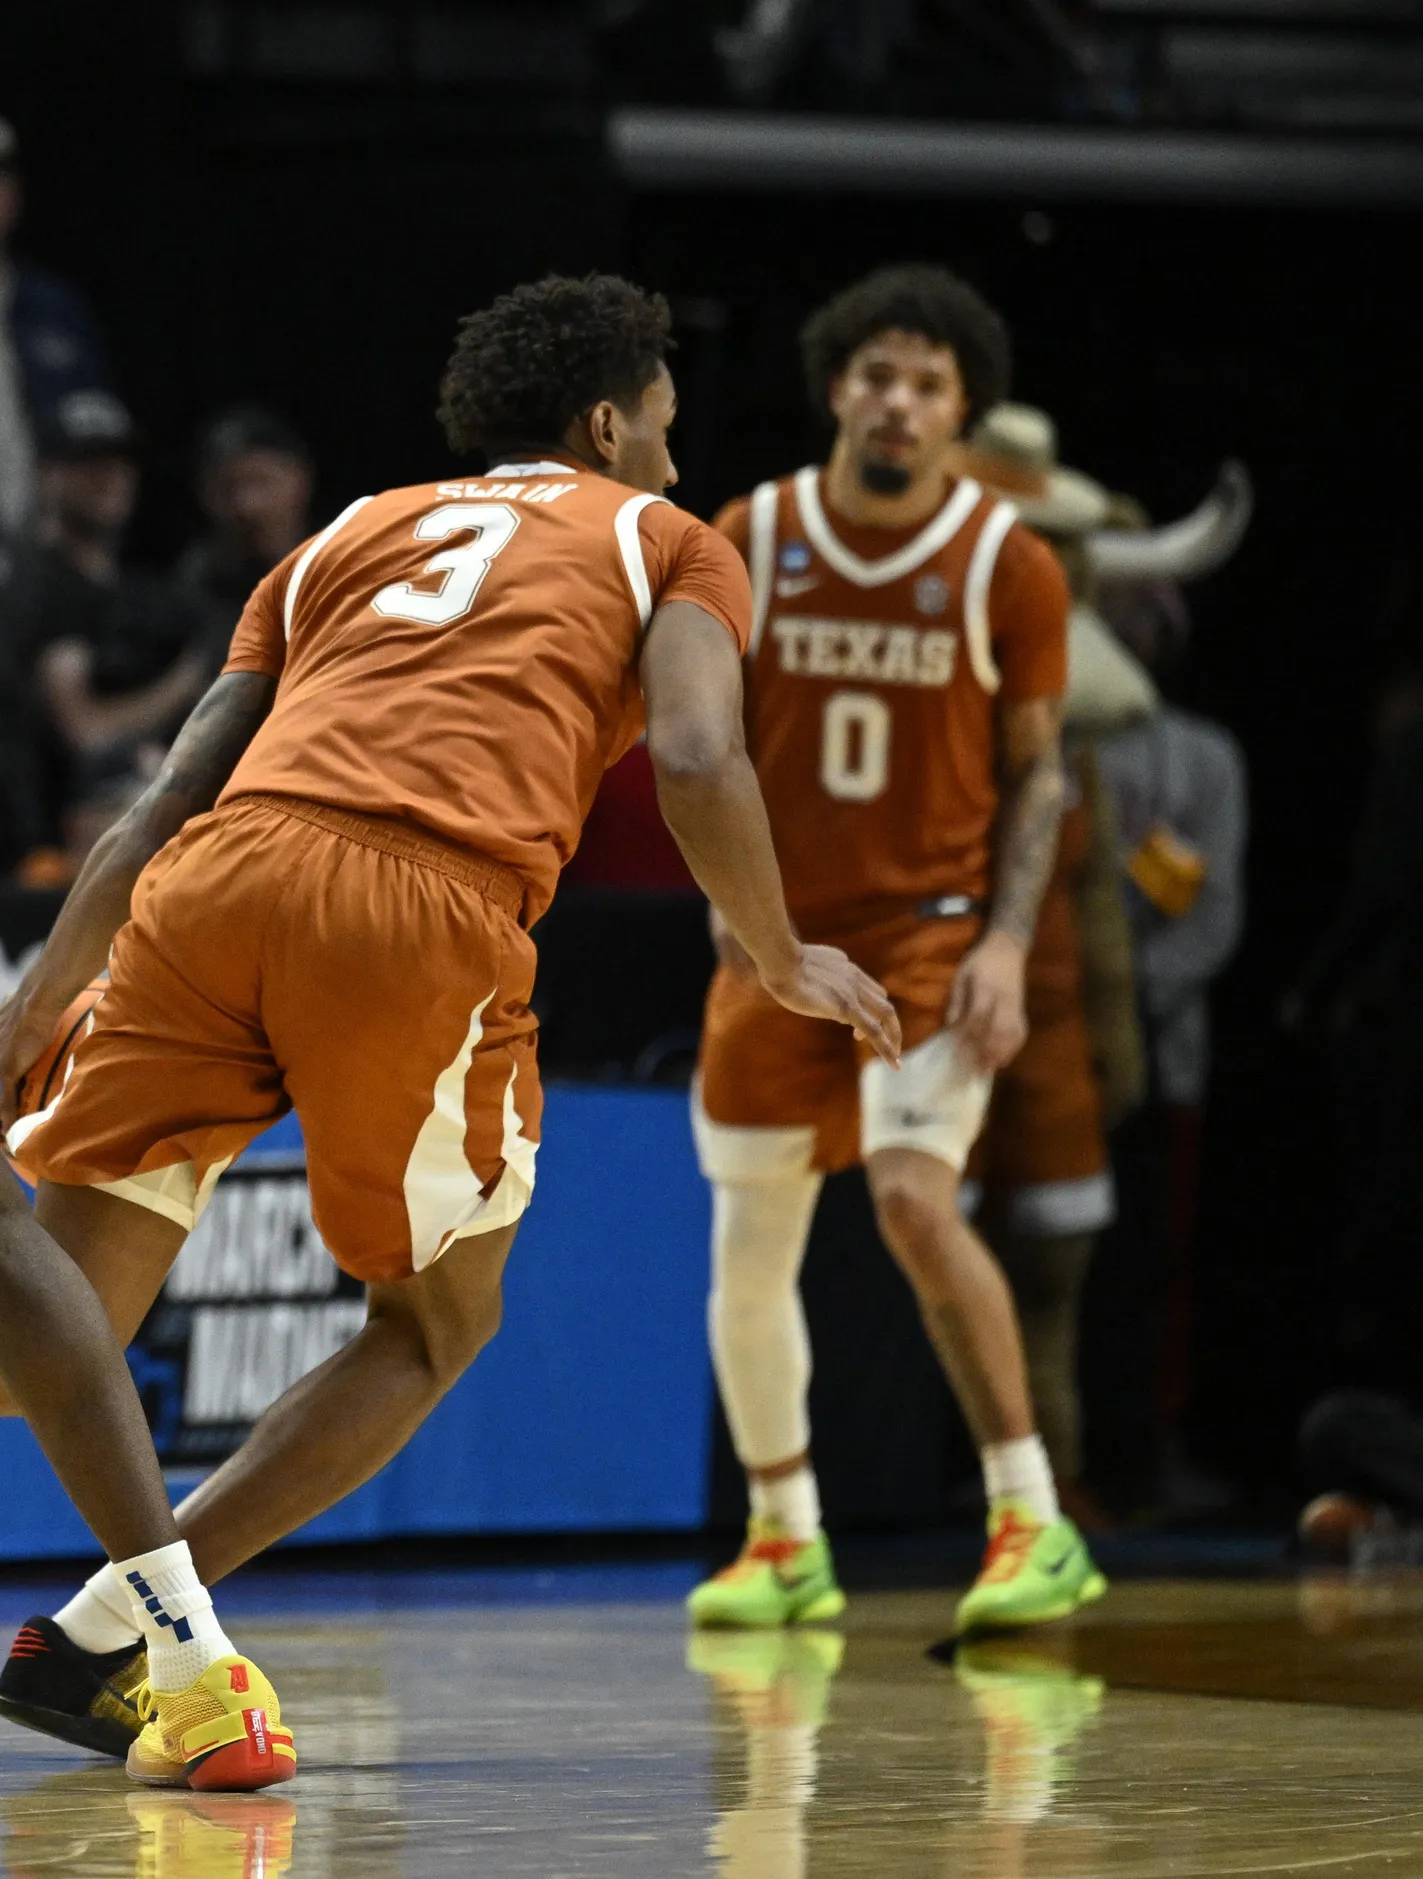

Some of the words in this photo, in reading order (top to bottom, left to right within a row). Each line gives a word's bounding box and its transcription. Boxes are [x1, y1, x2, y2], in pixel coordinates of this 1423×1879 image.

[436, 482, 578, 503] SWAIN
[370, 502, 522, 628] 3
[772, 616, 958, 688] TEXAS
[820, 689, 891, 804] 0
